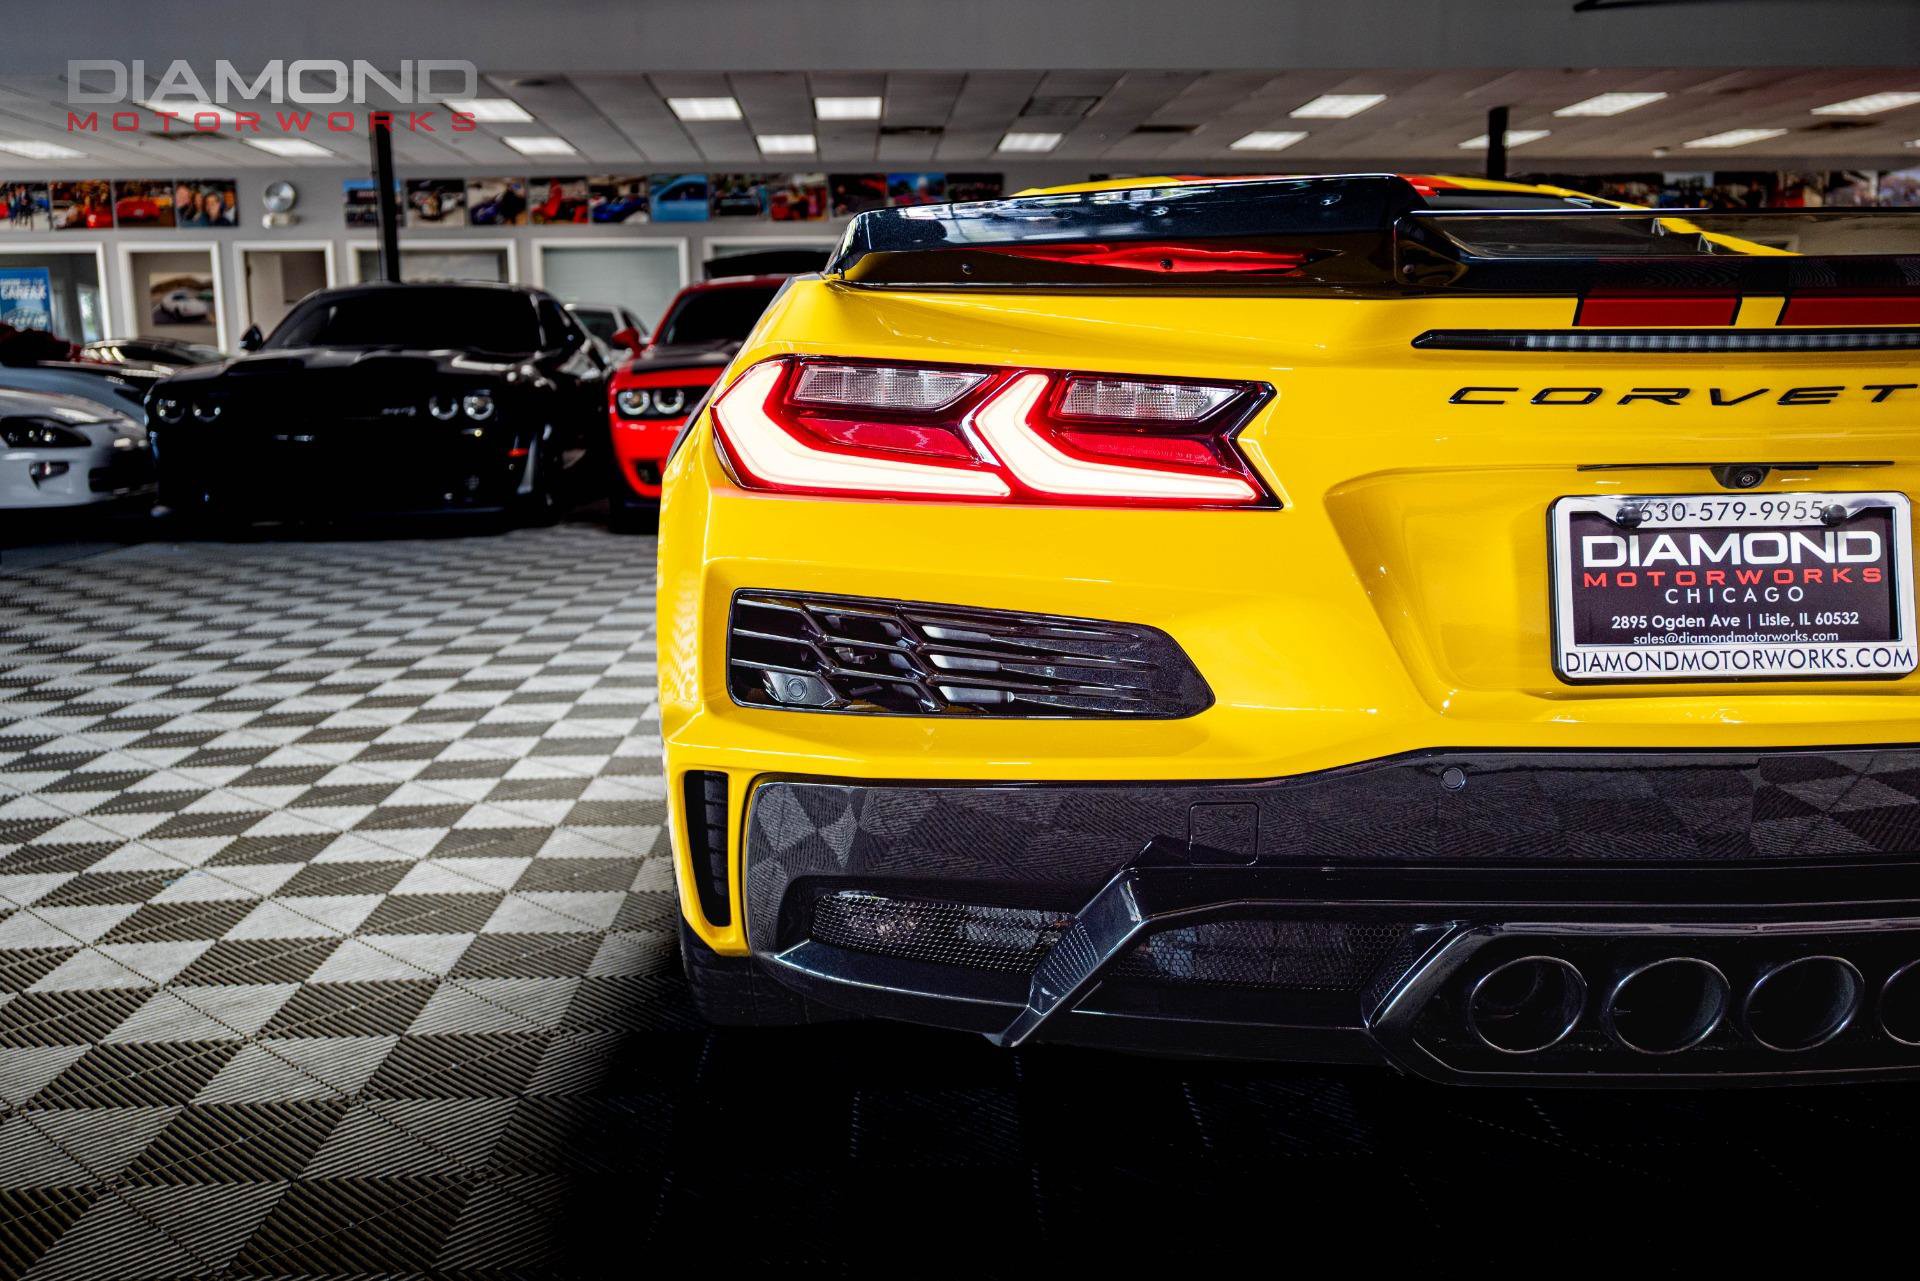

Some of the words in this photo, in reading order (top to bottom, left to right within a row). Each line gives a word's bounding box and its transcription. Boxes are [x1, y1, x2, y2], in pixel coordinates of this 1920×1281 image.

[1448, 384, 1919, 405] CORVET
[1639, 500, 1824, 522] 630-579-9955
[1582, 530, 1882, 568] DIAMOND
[1583, 567, 1882, 588] MOTORWORKS
[1665, 586, 1804, 604] CHICAGO
[1611, 615, 1648, 629] 2895
[1651, 614, 1706, 631] Ogden
[1710, 614, 1741, 628] Ave
[1759, 612, 1795, 627] Lisle,
[1799, 612, 1812, 626] IL
[1815, 611, 1860, 626] 60532
[1633, 629, 1839, 645] sales@diamondmotorworks.com
[1566, 647, 1914, 673] DIAMONDMOTORWORKS.COM
